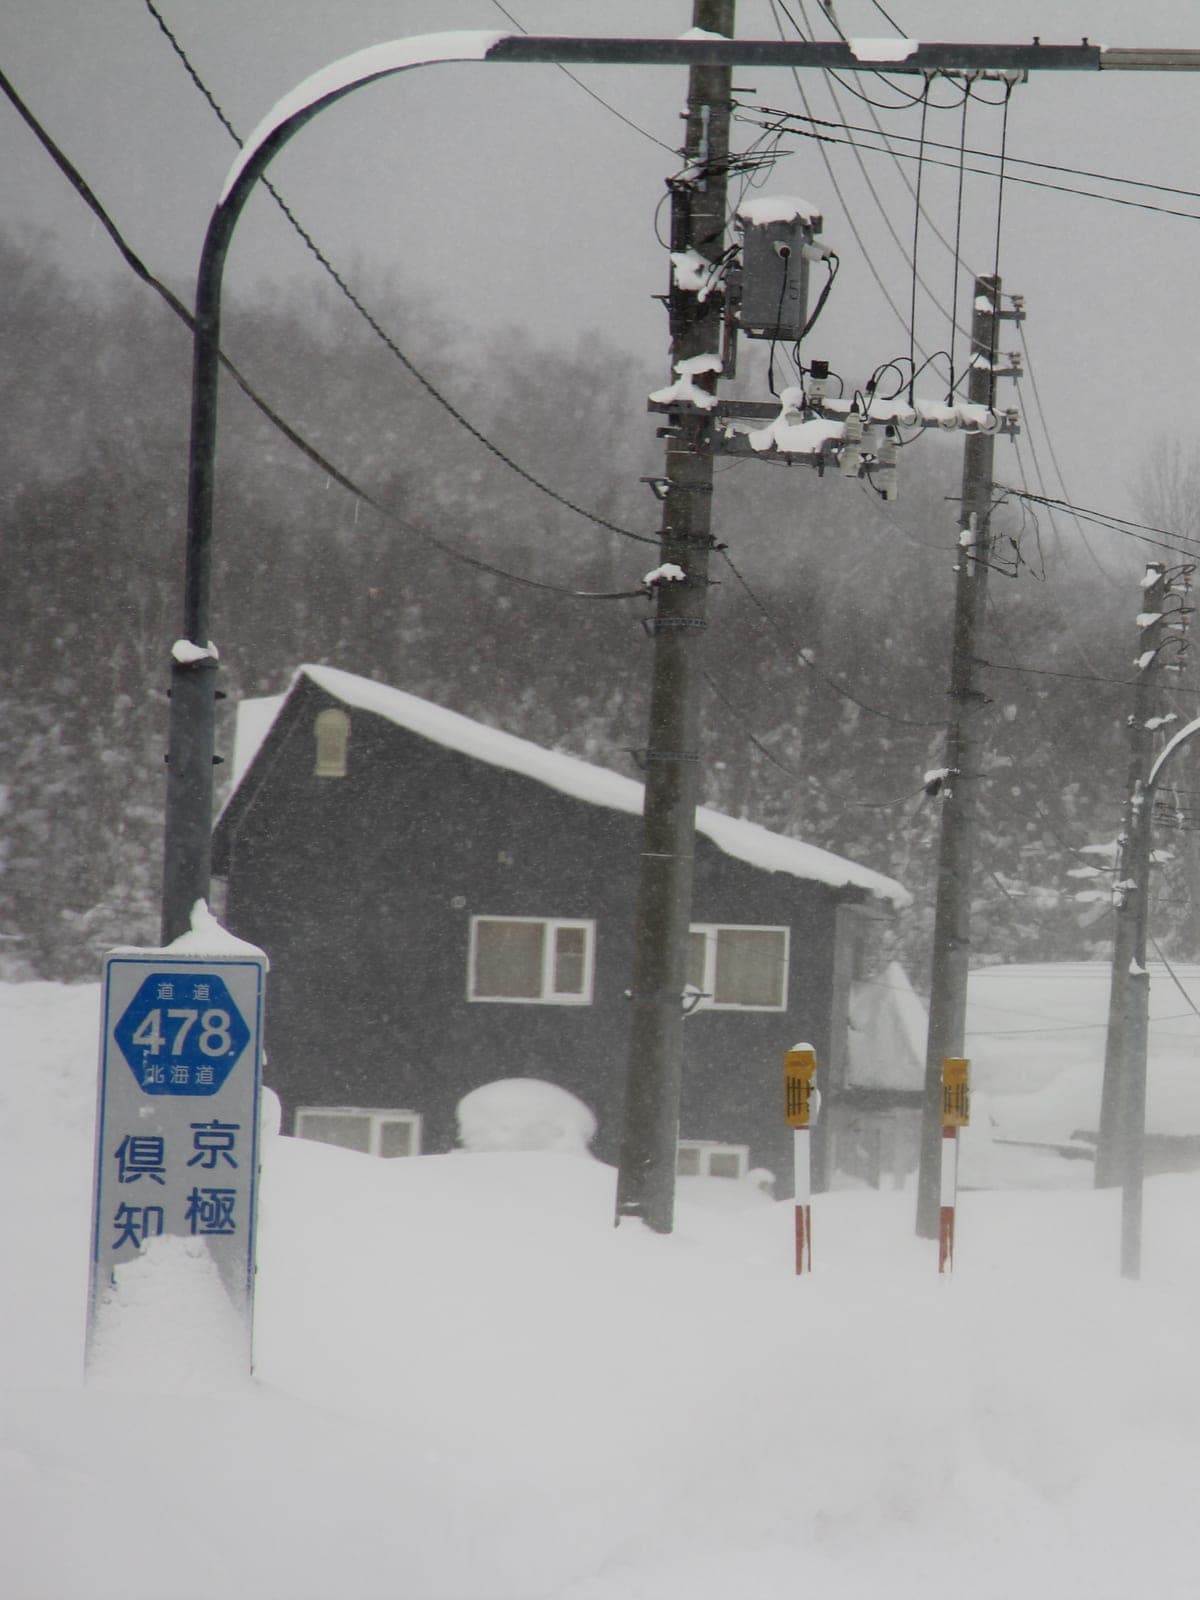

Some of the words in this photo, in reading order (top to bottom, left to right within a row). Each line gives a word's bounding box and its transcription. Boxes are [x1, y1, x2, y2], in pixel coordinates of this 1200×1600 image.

[157, 982, 210, 1000] 道道
[132, 1008, 231, 1057] 478
[145, 1064, 214, 1085] 北海道
[185, 1119, 240, 1235] 京極
[111, 1134, 166, 1284] 倶知
